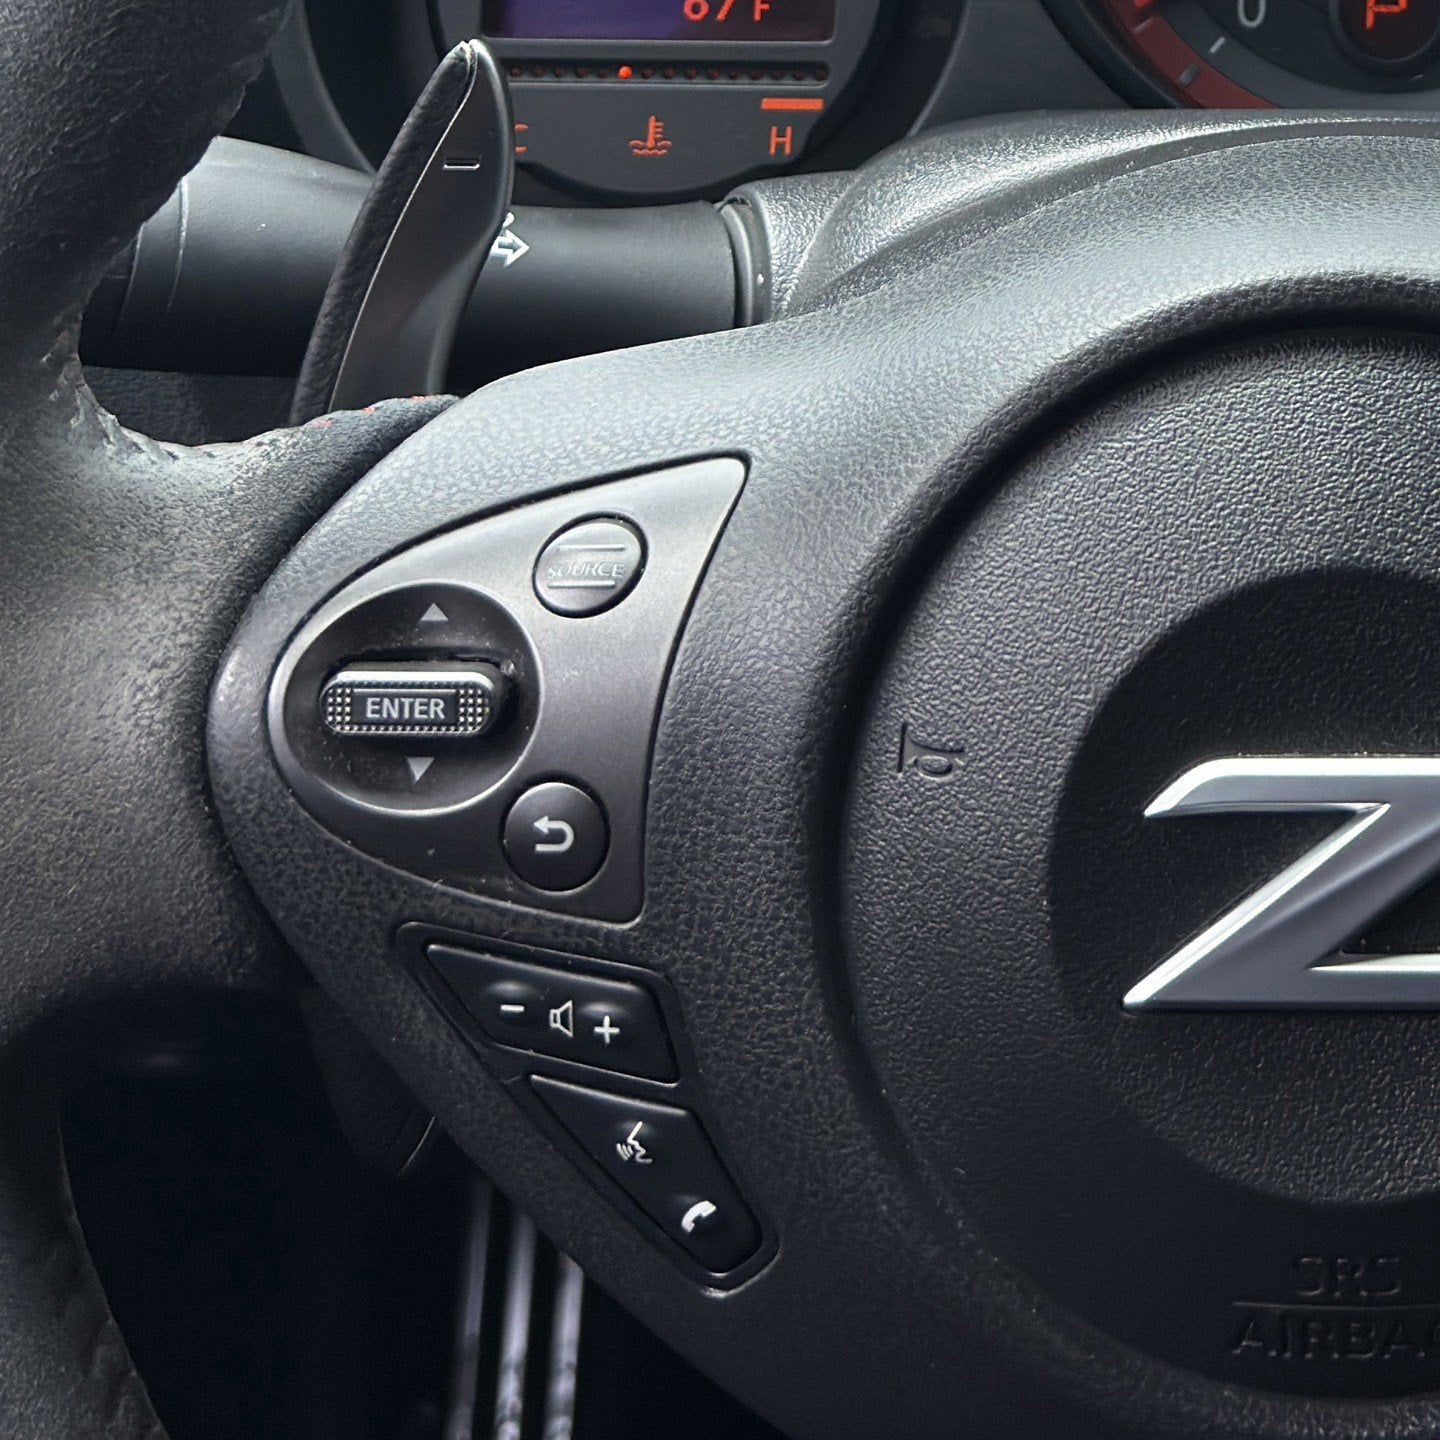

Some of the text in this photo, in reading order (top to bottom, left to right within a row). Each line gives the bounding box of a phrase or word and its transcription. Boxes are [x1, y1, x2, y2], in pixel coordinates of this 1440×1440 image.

[769, 126, 792, 155] H
[547, 561, 624, 579] SOURCE
[365, 696, 446, 720] ENTER
